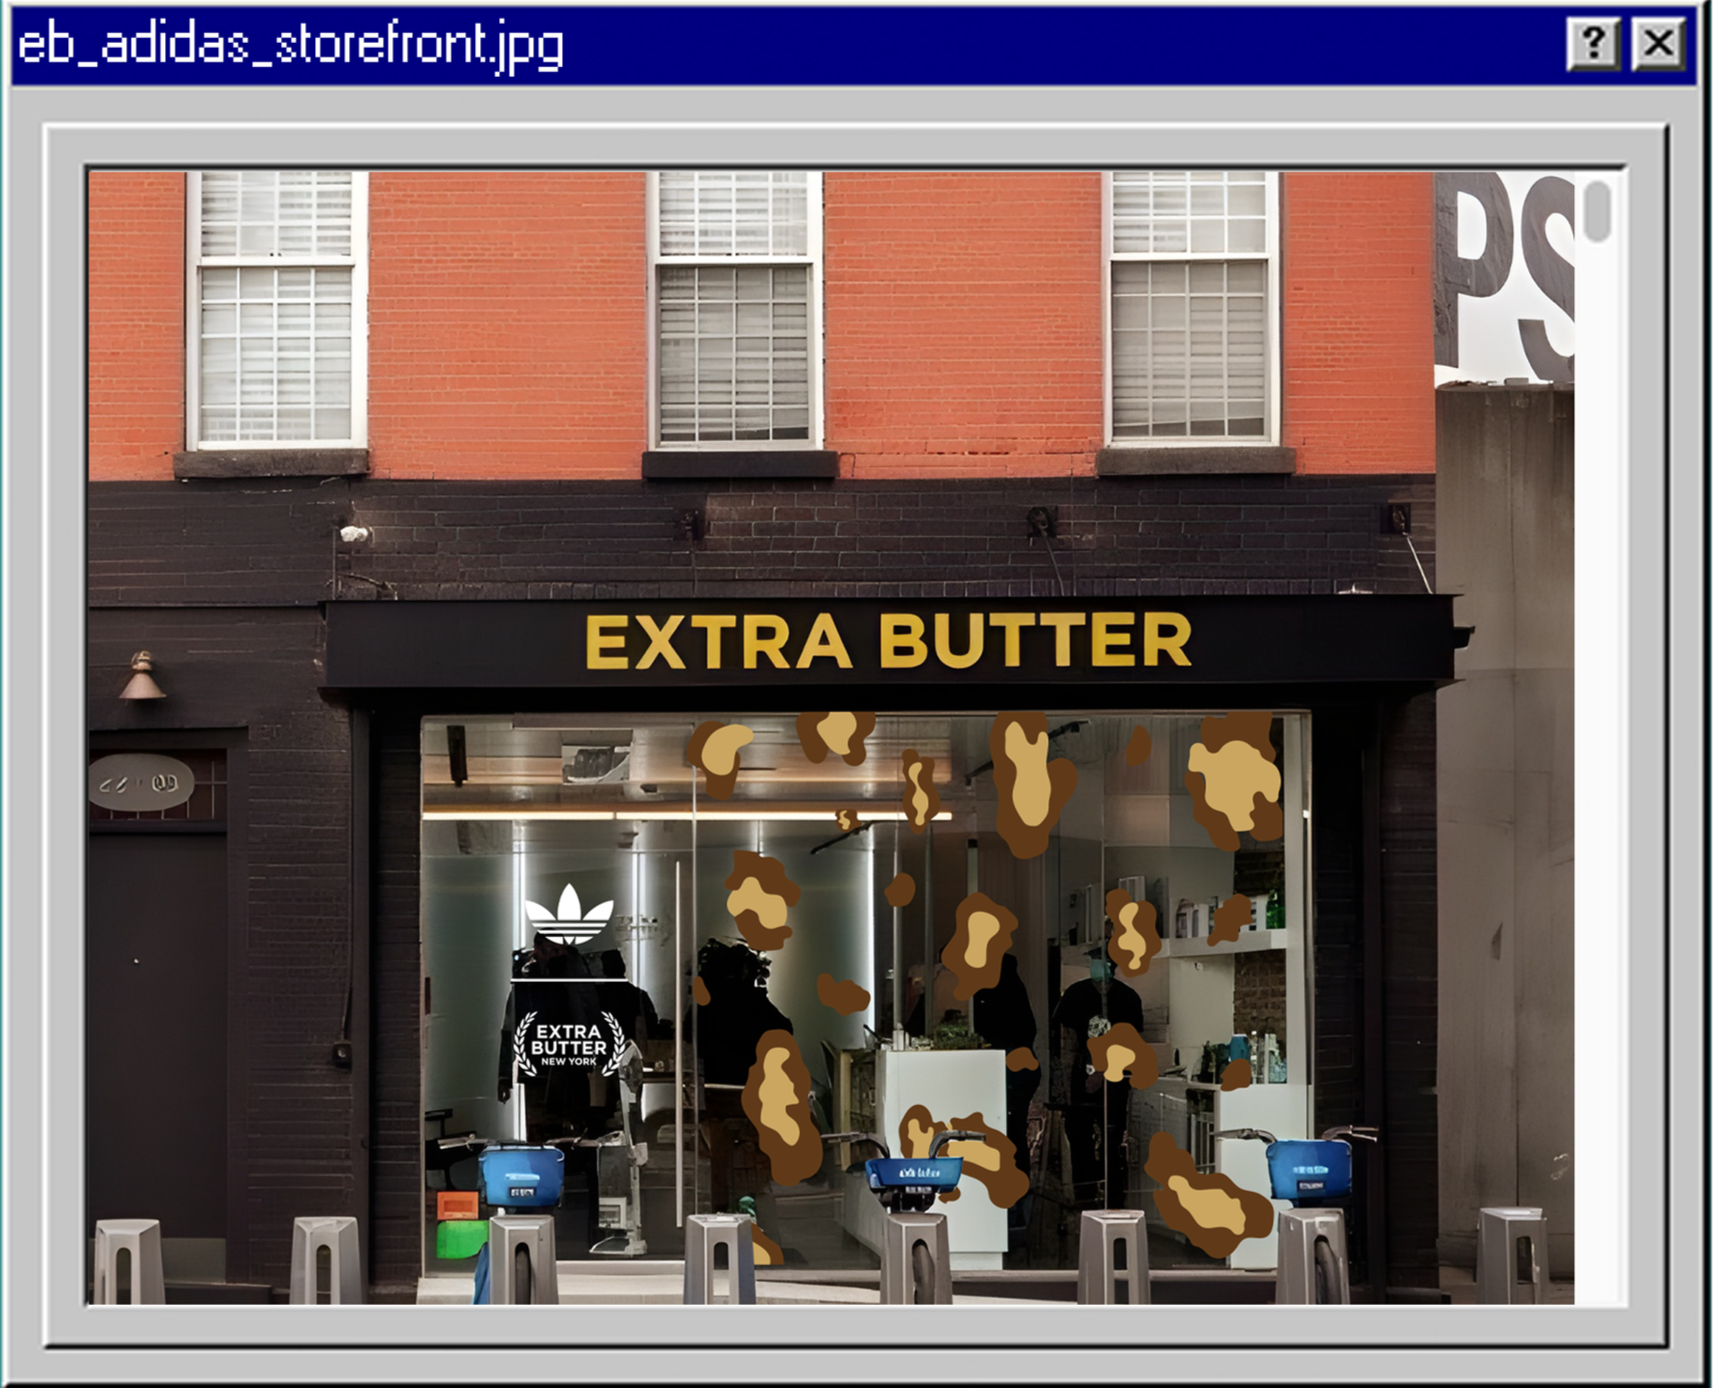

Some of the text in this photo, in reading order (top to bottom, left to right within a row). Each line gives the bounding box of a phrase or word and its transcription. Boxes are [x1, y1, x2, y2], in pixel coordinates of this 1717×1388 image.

[586, 612, 1193, 669] EXTRA BUTTER
[536, 1024, 602, 1039] EXTRA
[531, 1040, 607, 1055] BUTTER
[541, 1057, 597, 1066] NEW YORK
